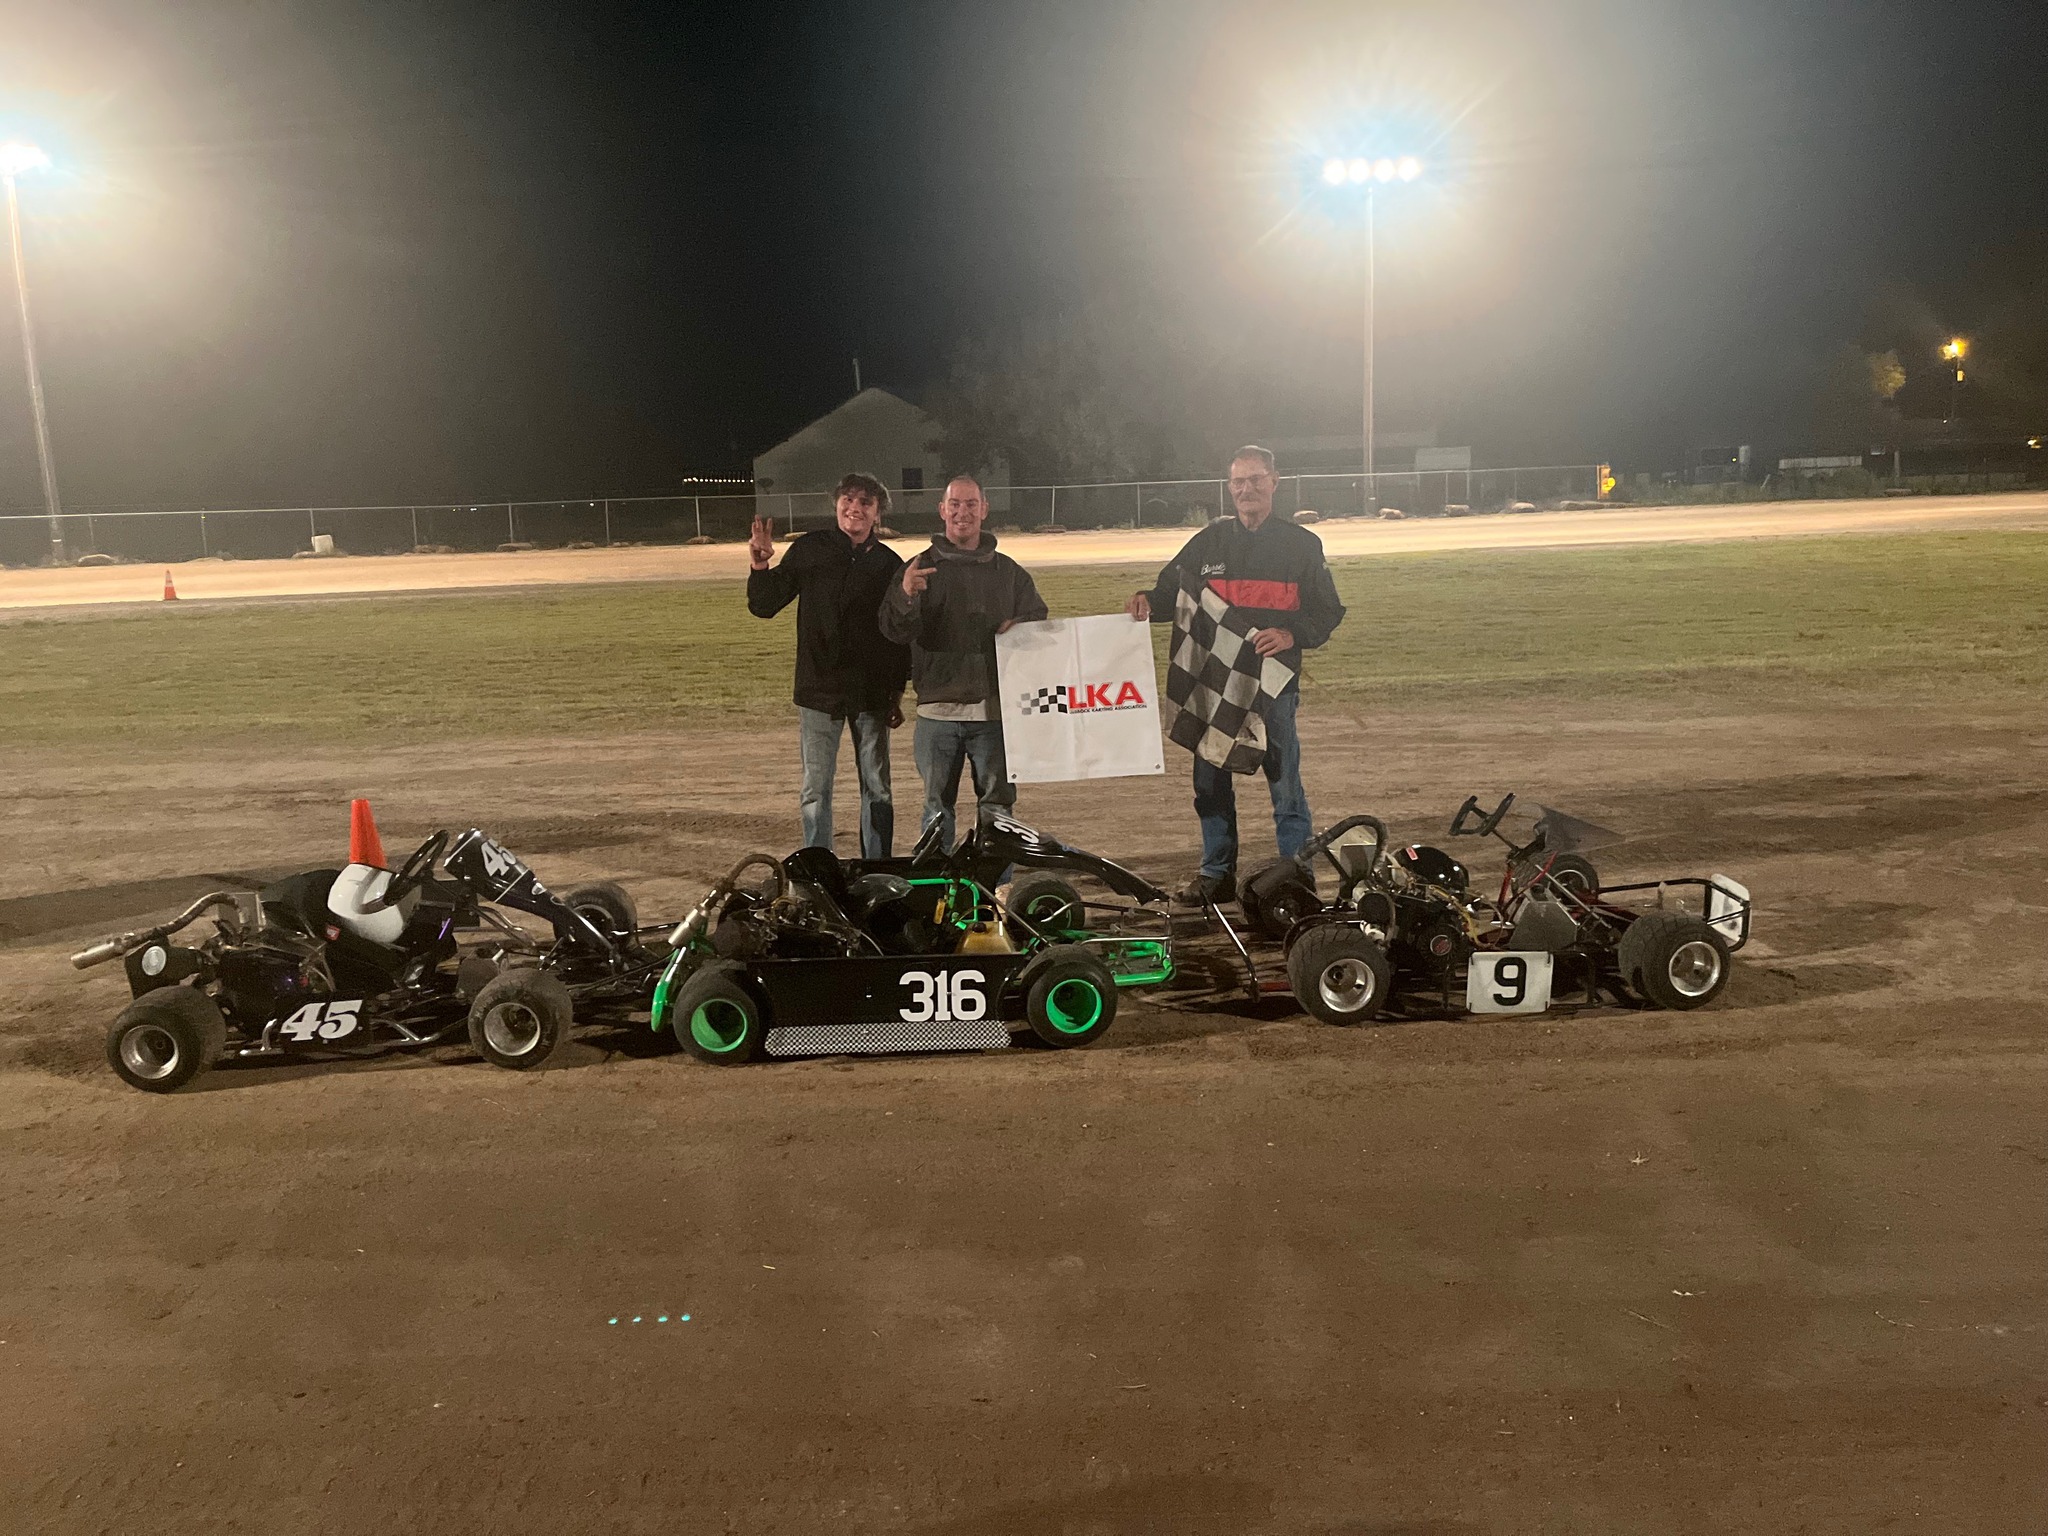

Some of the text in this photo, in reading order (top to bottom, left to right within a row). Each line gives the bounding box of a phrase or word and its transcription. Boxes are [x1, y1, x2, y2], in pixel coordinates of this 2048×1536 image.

[1068, 681, 1145, 709] LKA
[899, 969, 987, 1022] 316
[1493, 956, 1527, 1006] 9
[280, 999, 364, 1042] 45
